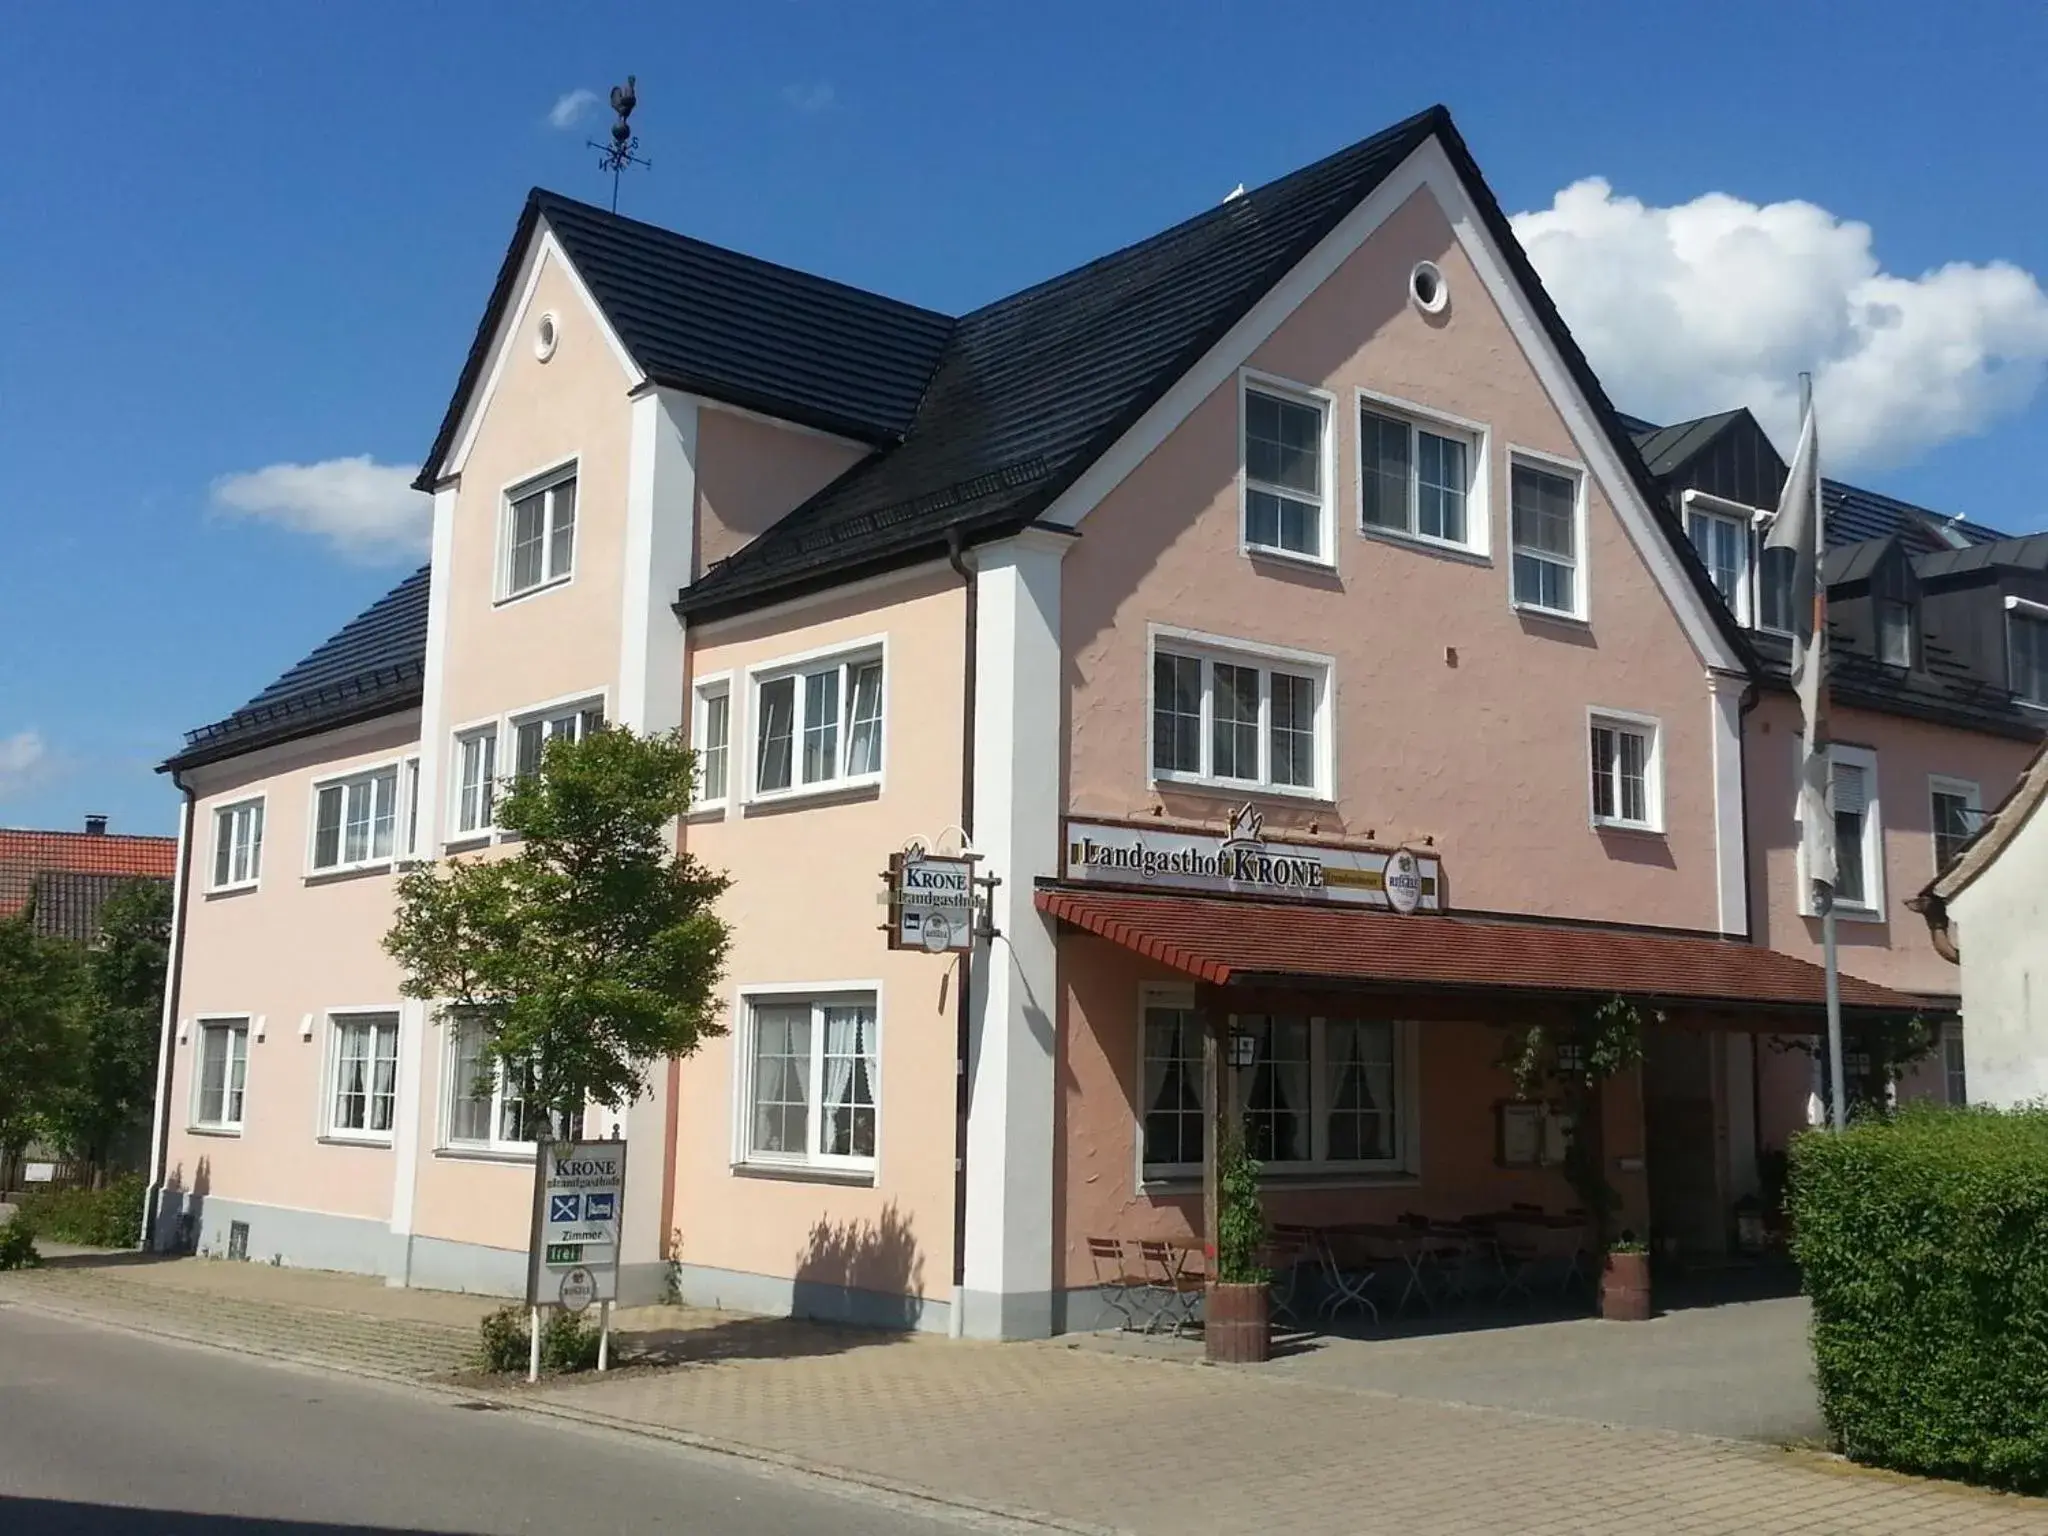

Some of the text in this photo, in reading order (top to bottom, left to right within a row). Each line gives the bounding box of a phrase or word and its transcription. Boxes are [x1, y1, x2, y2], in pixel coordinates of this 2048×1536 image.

[1081, 837, 1323, 888] Landgasthof KRONE
[906, 867, 968, 891] KRONE
[897, 889, 982, 908] Landgasthof
[555, 1159, 617, 1176] KRONE
[562, 1230, 602, 1241] Zimmer
[551, 1246, 575, 1260] frei
